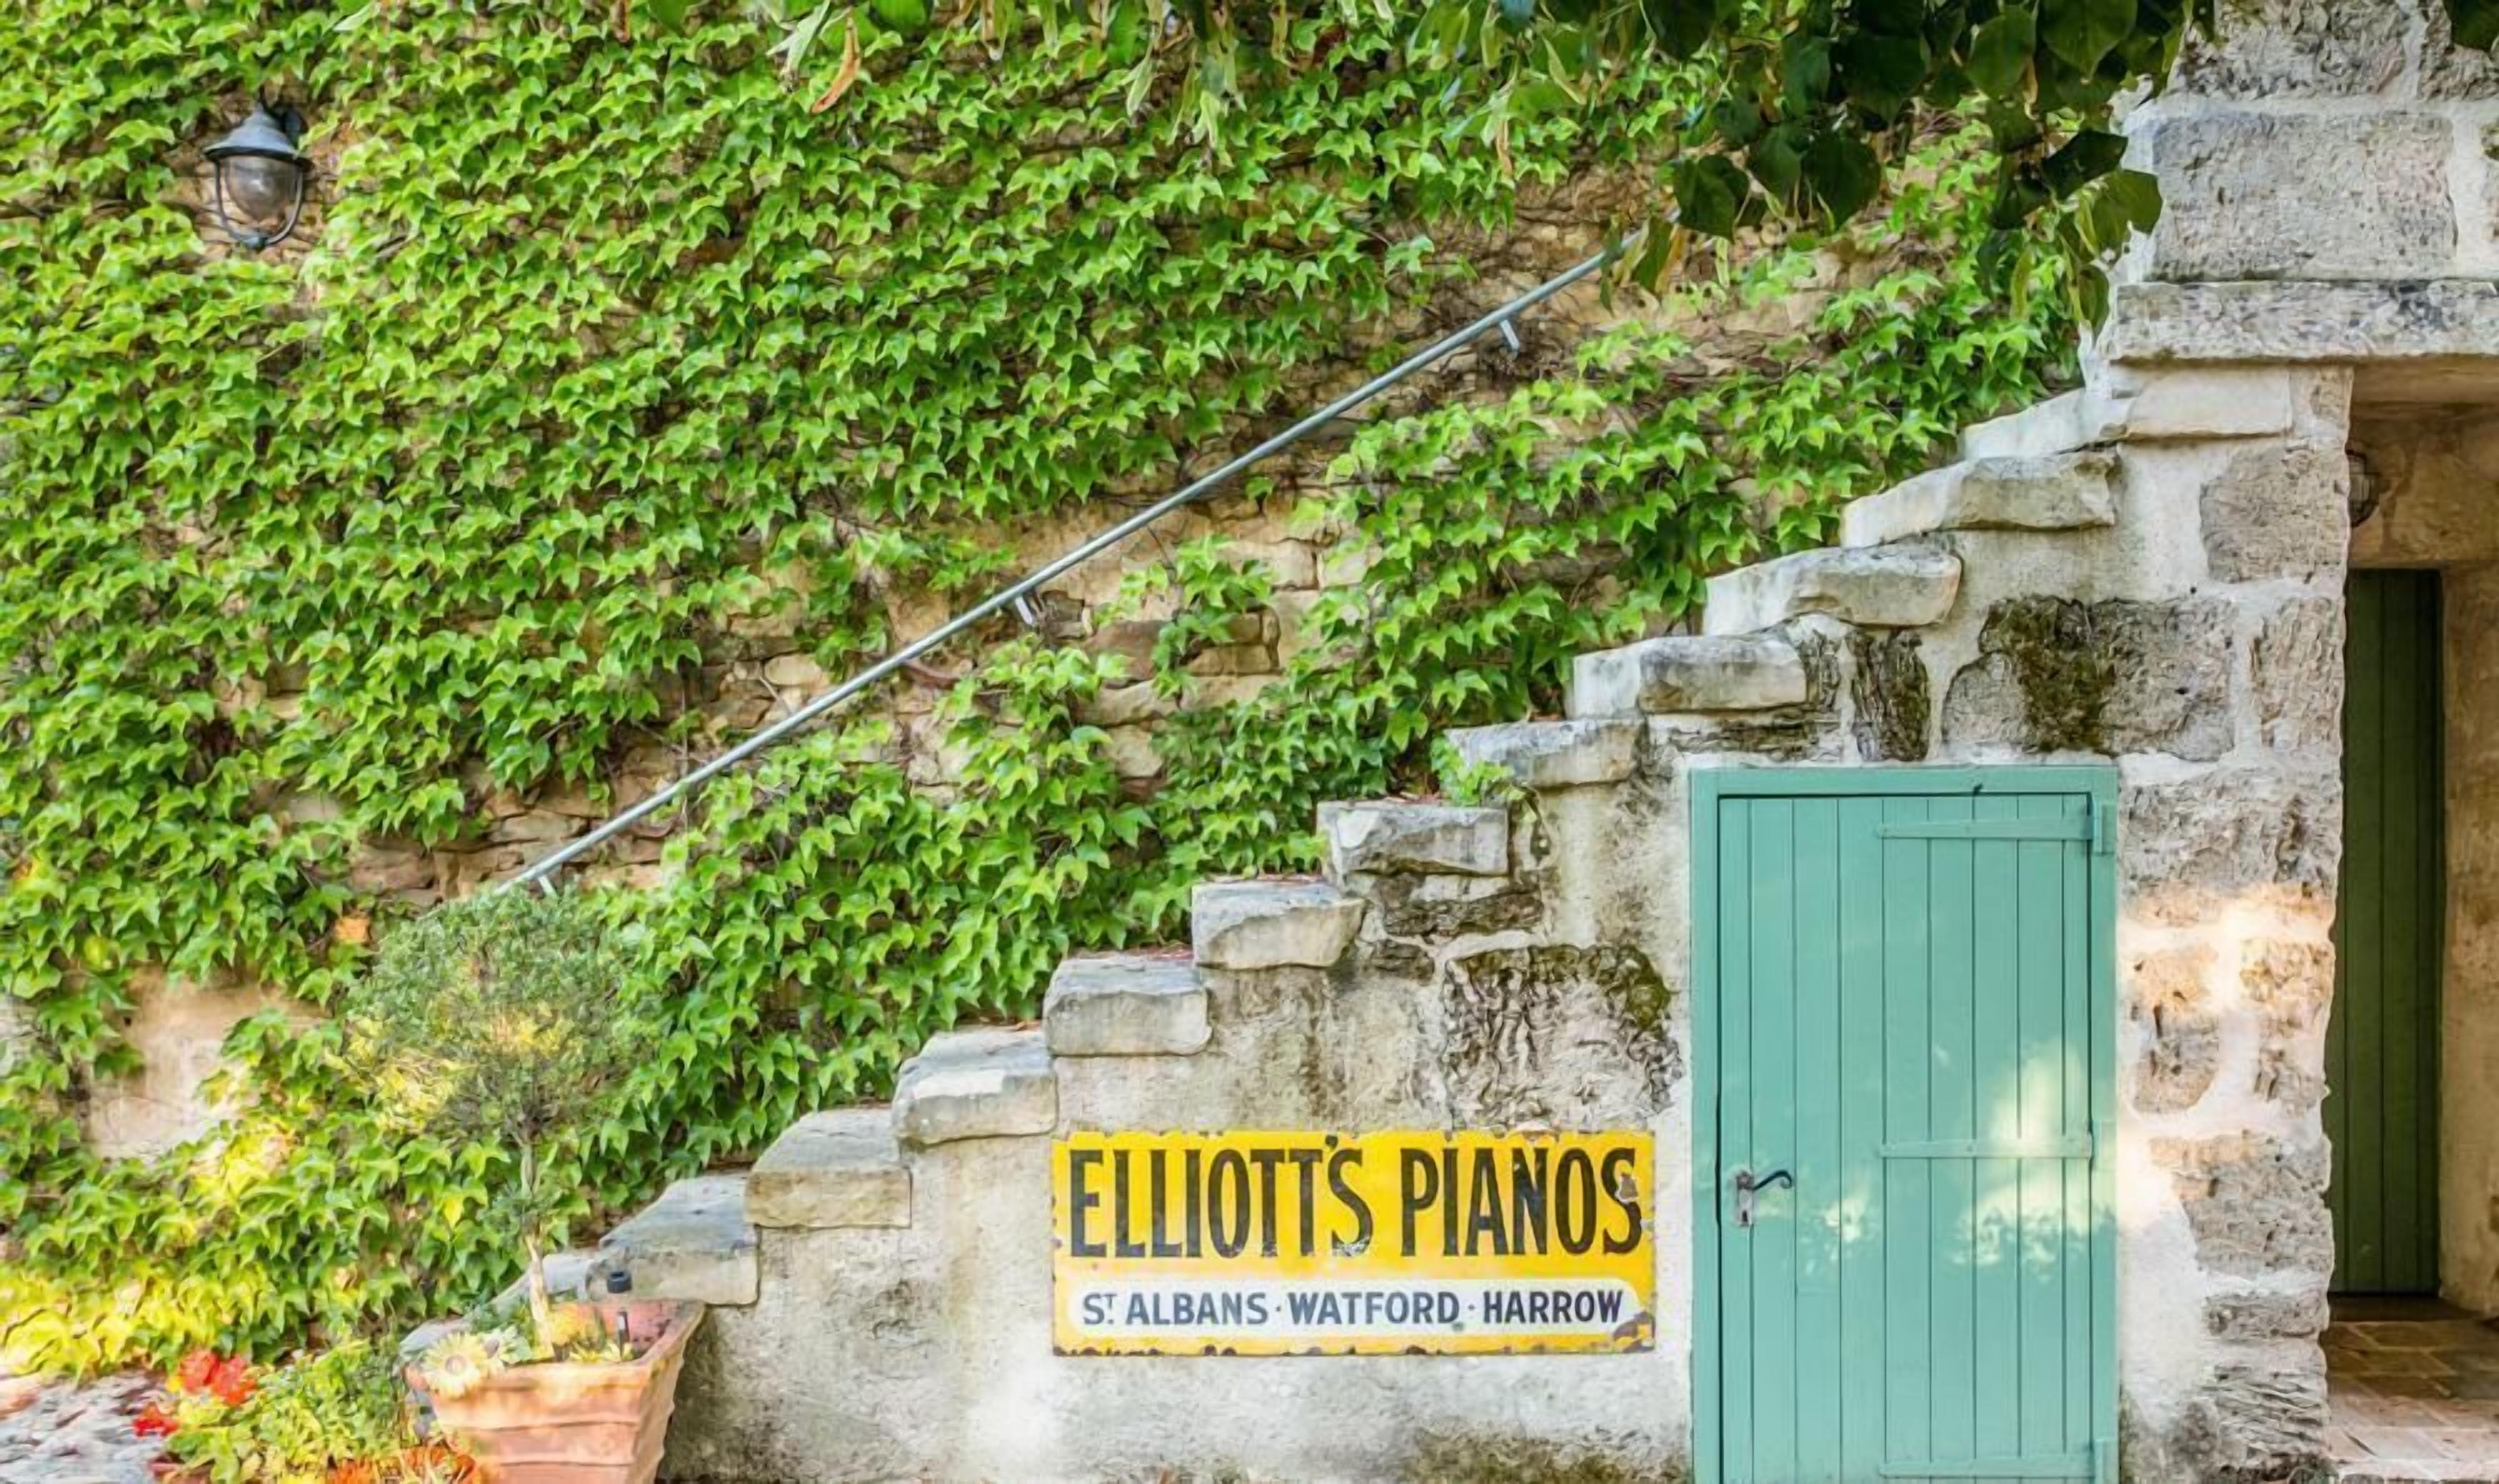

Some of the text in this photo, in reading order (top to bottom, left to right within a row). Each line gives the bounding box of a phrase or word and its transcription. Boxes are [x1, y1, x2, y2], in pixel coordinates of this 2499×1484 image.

[1070, 1135, 1642, 1259] ELLIOTT'S PIANOS
[1126, 1292, 1269, 1325] ALBANS
[1287, 1291, 1460, 1325] WATFORD
[1483, 1290, 1624, 1324] HARROW
